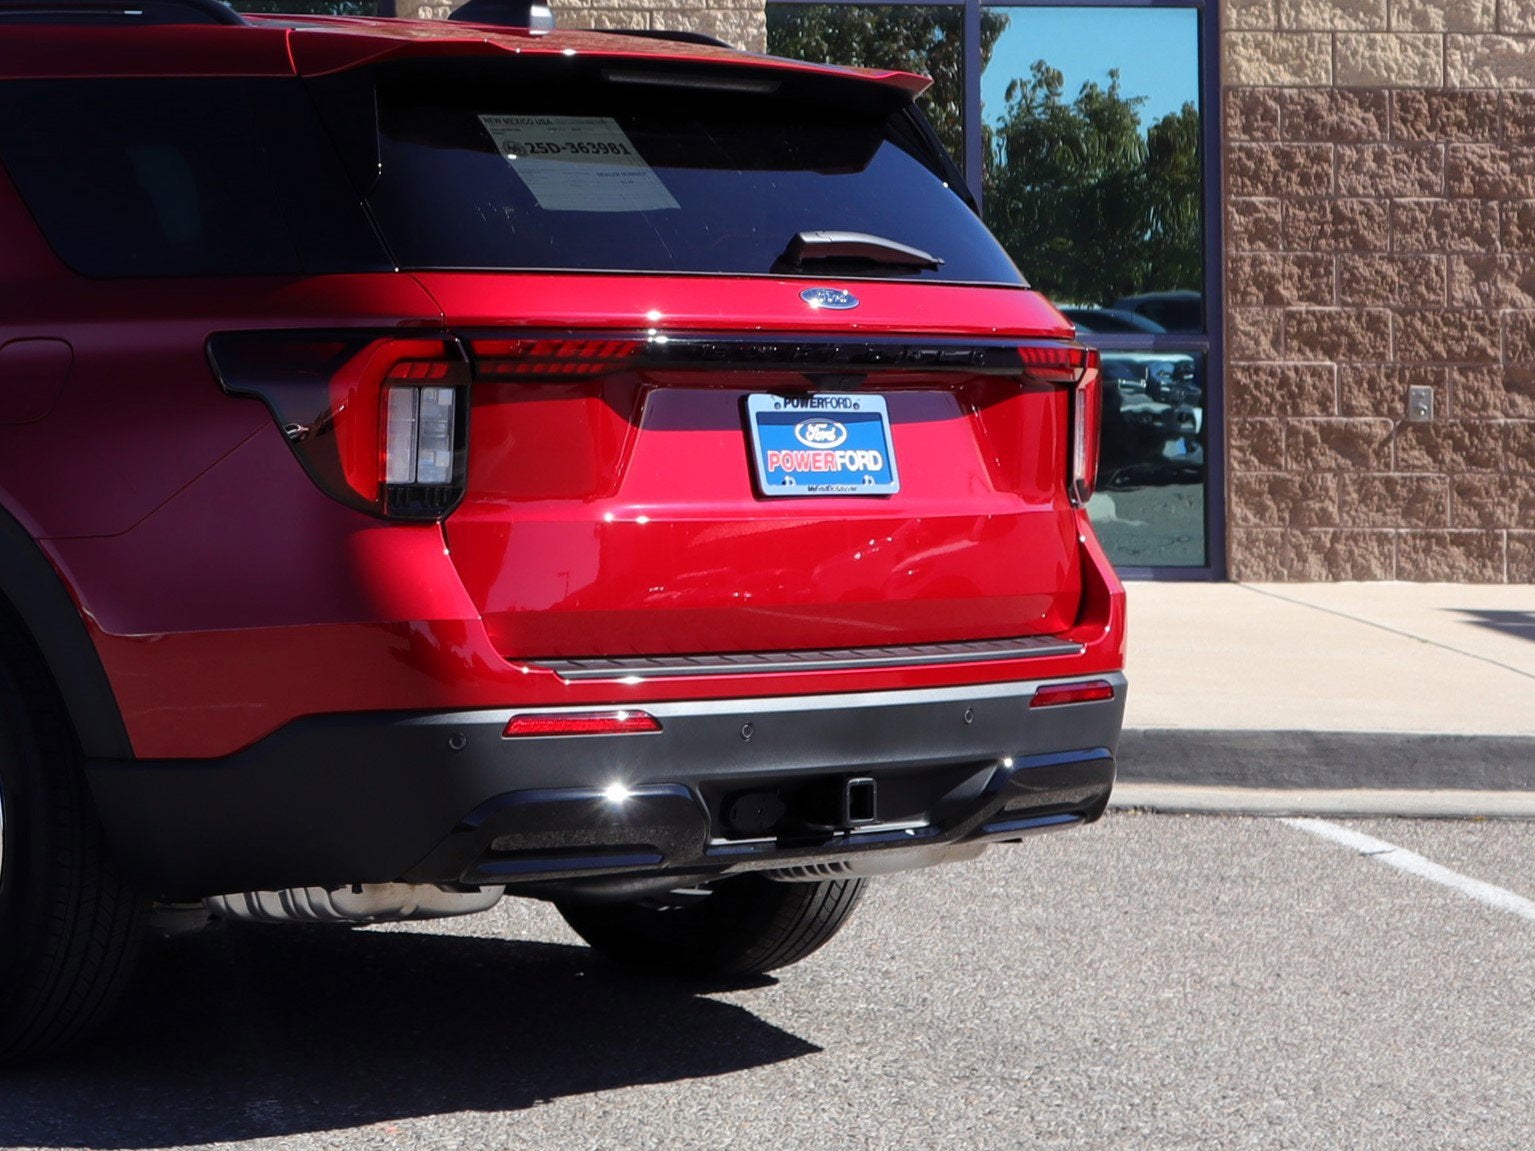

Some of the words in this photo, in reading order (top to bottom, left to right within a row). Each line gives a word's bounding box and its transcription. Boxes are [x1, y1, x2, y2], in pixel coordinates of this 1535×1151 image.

[504, 117, 533, 125] MEXICO
[535, 118, 552, 126] USA
[525, 142, 631, 155] 25D-363981
[805, 423, 838, 442] Ford
